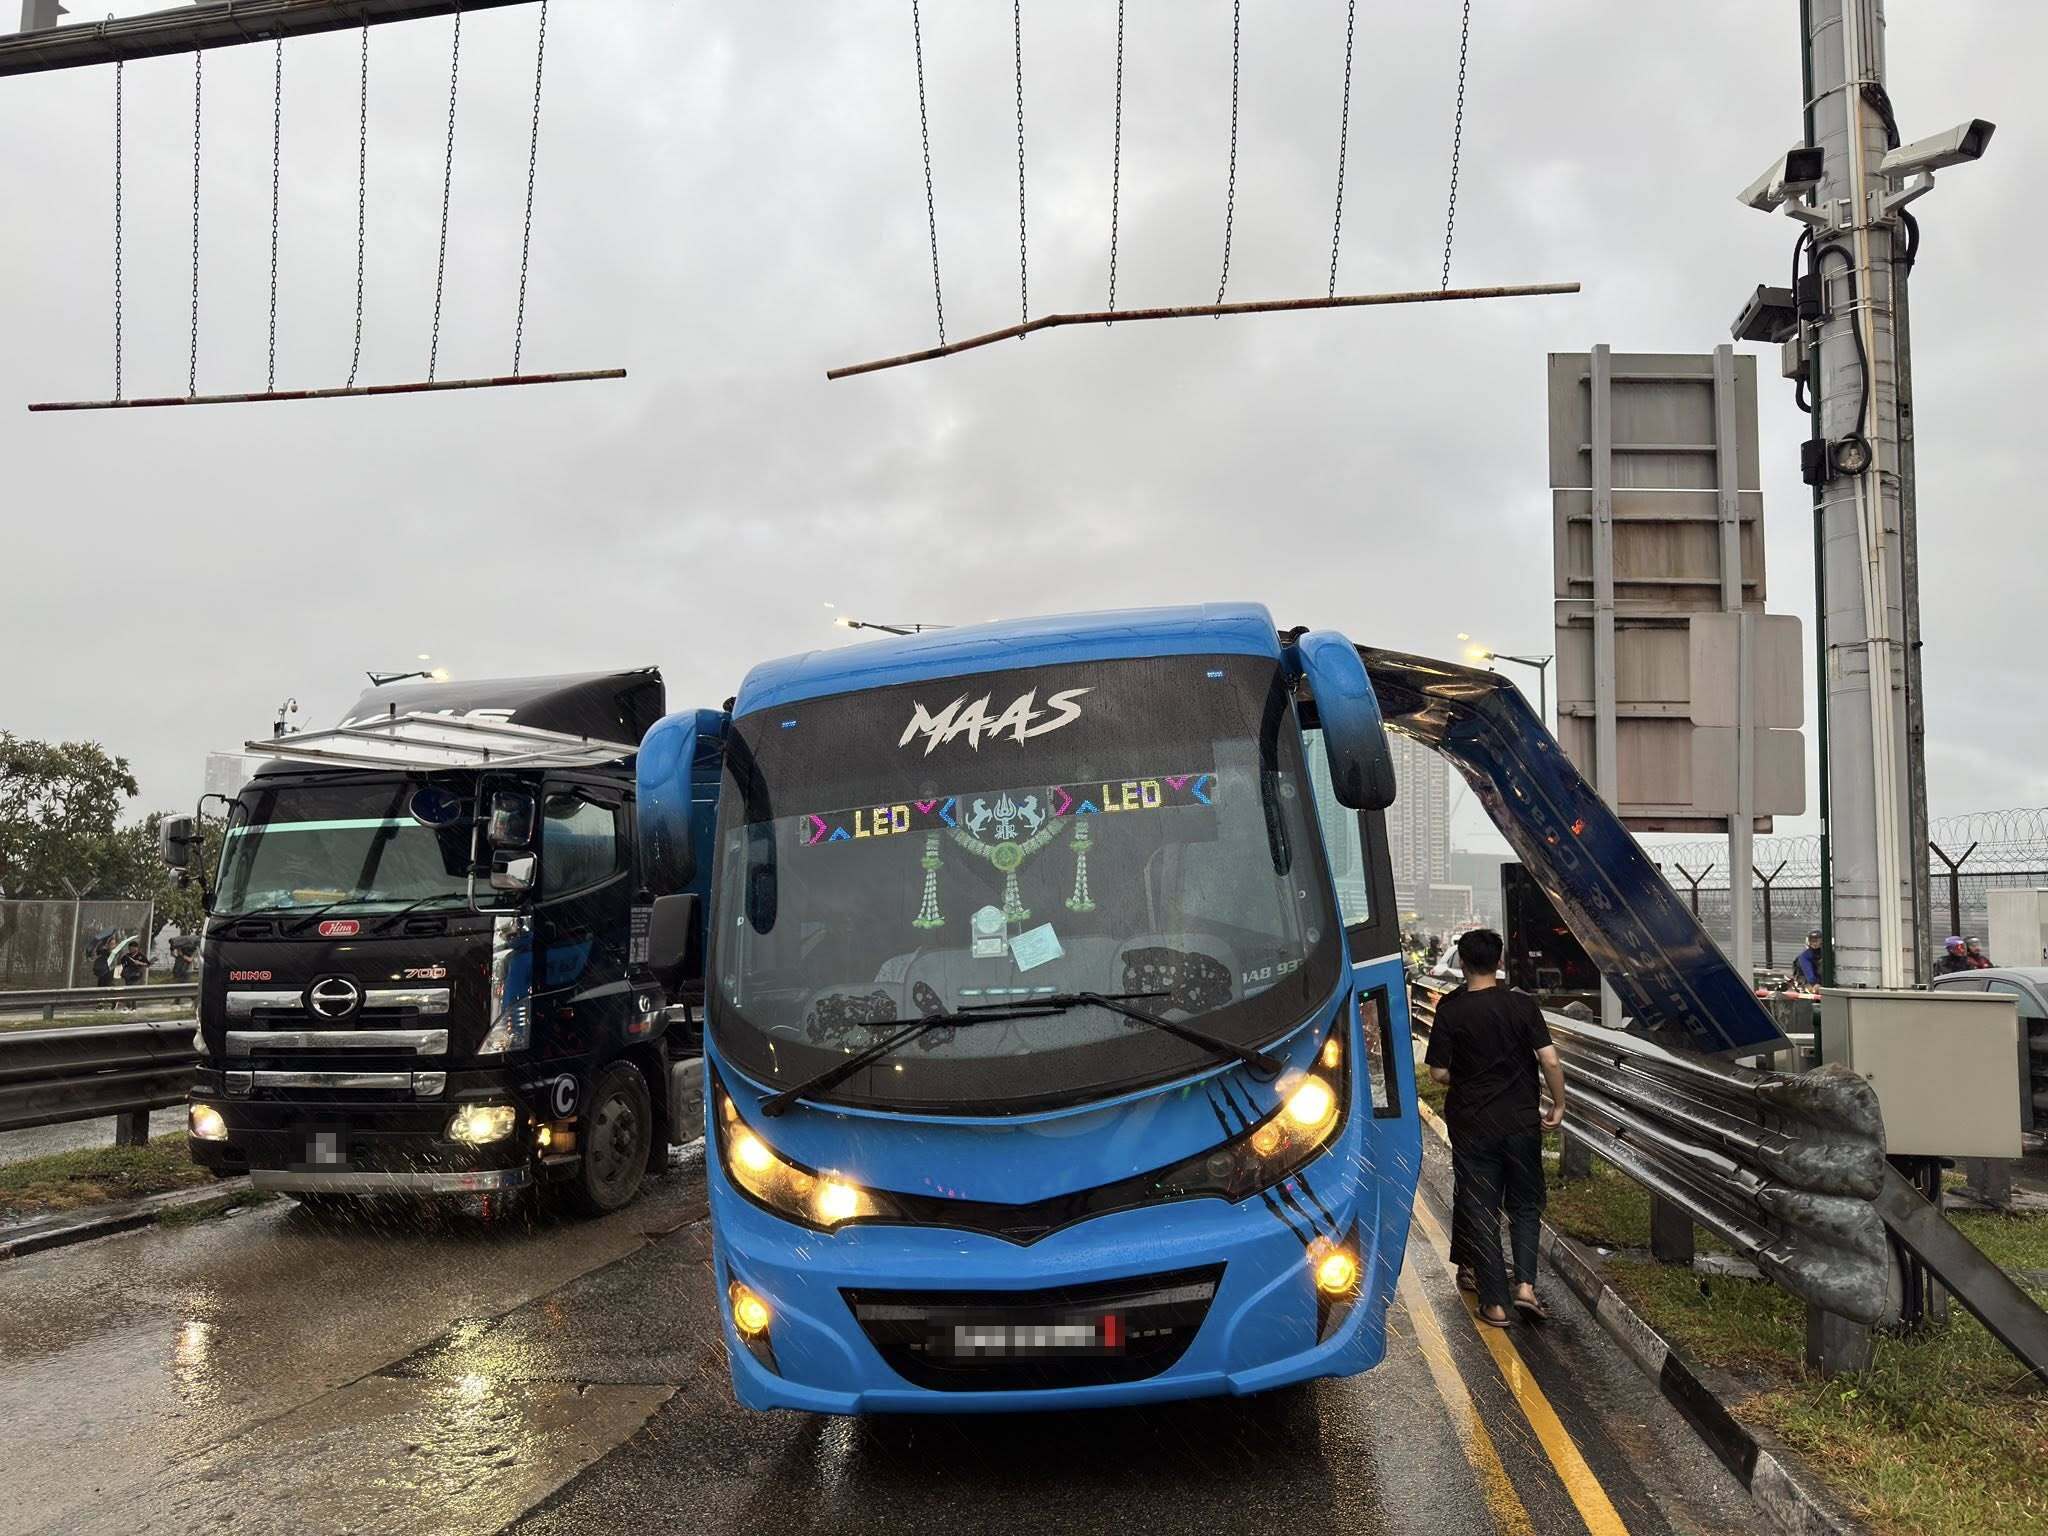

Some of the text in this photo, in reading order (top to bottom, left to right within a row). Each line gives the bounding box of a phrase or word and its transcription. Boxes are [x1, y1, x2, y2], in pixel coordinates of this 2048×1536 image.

[898, 686, 1096, 758] MAAS
[1102, 780, 1161, 812] LED
[855, 804, 910, 838] LED
[325, 921, 352, 935] Hino
[230, 970, 272, 981] HINO
[404, 967, 446, 979] 700
[556, 1078, 575, 1113] C
